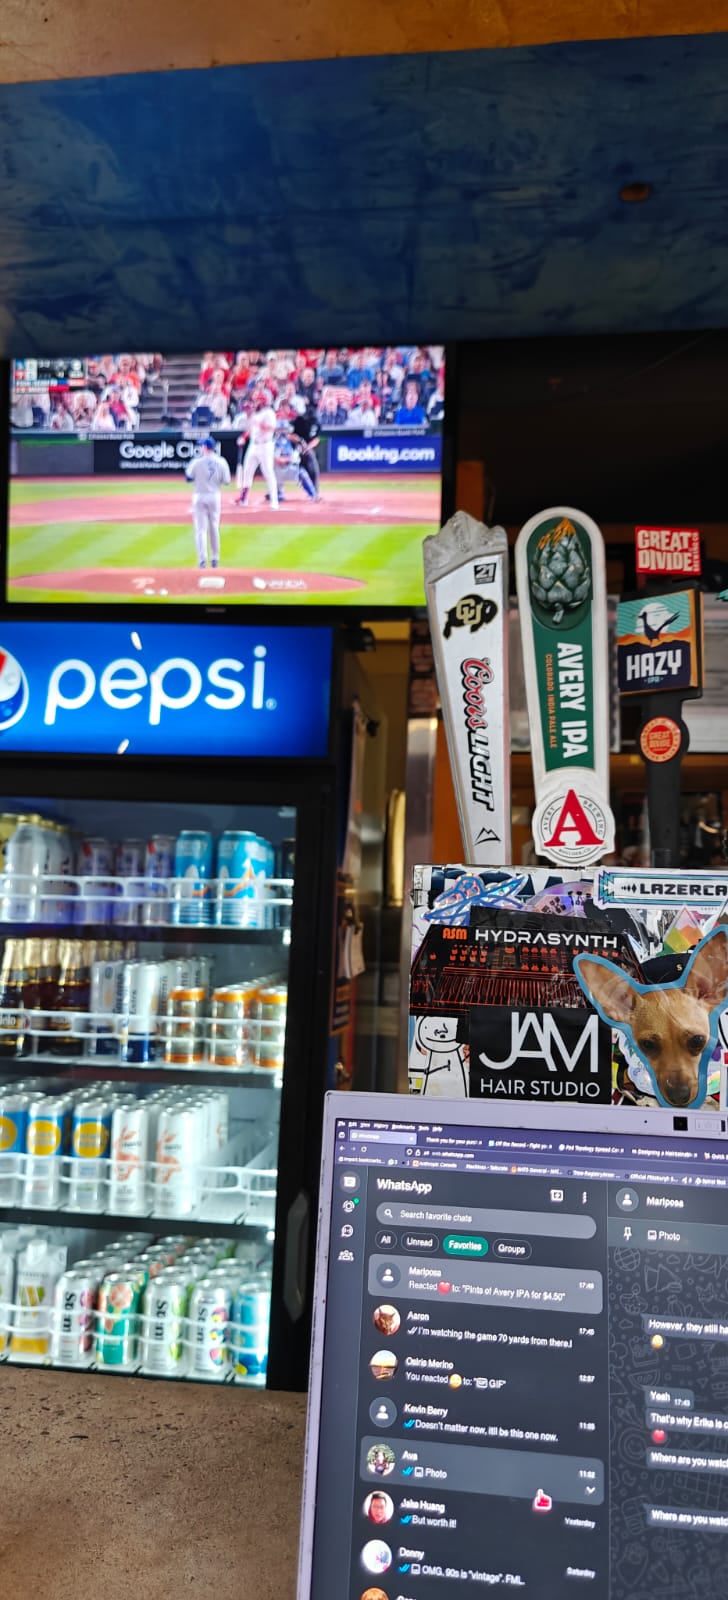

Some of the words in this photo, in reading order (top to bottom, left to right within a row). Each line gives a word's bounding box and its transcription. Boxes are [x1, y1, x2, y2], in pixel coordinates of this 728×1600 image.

[119, 440, 174, 463] Google
[337, 445, 434, 464] Booking.com
[638, 530, 691, 551] GREAT
[638, 549, 693, 572] DIVIDE
[476, 564, 495, 579] 21
[545, 653, 554, 691] COLORADO
[626, 649, 682, 681] HAZY
[557, 642, 586, 711] AVERY
[44, 645, 267, 725] pepsi
[461, 658, 494, 730] Coors
[549, 735, 558, 749] ALE
[561, 720, 589, 758] IPA
[467, 730, 495, 812] LIGHT
[544, 789, 604, 847] A
[640, 883, 727, 896] LAZERCA
[443, 928, 467, 940] ASM
[475, 929, 617, 948] HYDRASYNTH
[478, 1012, 598, 1073] JAM
[480, 1078, 525, 1095] HAIR
[530, 1079, 600, 1097] STUDIO
[377, 1178, 432, 1194] WhatsApp
[400, 1210, 424, 1218] Search
[426, 1212, 451, 1220] favorite
[453, 1214, 472, 1222] chats
[380, 1235, 390, 1243] All
[406, 1237, 432, 1246] Unread
[658, 1230, 681, 1240] Photo
[448, 1240, 481, 1250] Favorites
[498, 1244, 524, 1254] Groups
[409, 1266, 441, 1276] Mariposa
[408, 1280, 438, 1290] Reacted
[484, 1286, 492, 1295] of
[492, 1288, 515, 1300] Avery
[516, 1289, 530, 1298] IPA
[531, 1290, 541, 1299] for
[407, 1311, 429, 1320] Aaron
[648, 1319, 684, 1330] However,
[686, 1322, 702, 1333] they
[704, 1324, 718, 1333] still
[416, 1326, 429, 1334] I'm
[430, 1328, 462, 1339] watching
[476, 1333, 496, 1341] game
[498, 1333, 507, 1341] 70
[508, 1336, 529, 1344] yards
[530, 1336, 547, 1344] from
[428, 1359, 453, 1369] Merino
[406, 1372, 420, 1381] You
[421, 1374, 449, 1384] reacted
[650, 1391, 670, 1401] Yeah
[404, 1403, 426, 1413] Kevin
[426, 1406, 448, 1417] Berry
[650, 1412, 675, 1424] That's
[676, 1416, 692, 1427] why
[715, 1419, 722, 1428] is
[415, 1419, 444, 1429] Doesn't
[444, 1424, 468, 1432] matter
[469, 1426, 486, 1434] now,
[498, 1427, 508, 1436] be
[510, 1429, 523, 1437] this
[524, 1431, 538, 1439] one
[540, 1433, 558, 1441] now.
[402, 1450, 417, 1460] Ava
[651, 1452, 676, 1463] Where
[677, 1456, 690, 1464] are
[692, 1458, 706, 1466] you
[425, 1468, 446, 1478] Photo
[419, 1500, 444, 1513] Huang
[412, 1514, 425, 1524] But
[426, 1518, 448, 1526] worth
[564, 1517, 595, 1528] Yesterday
[651, 1510, 677, 1521] Where
[678, 1514, 692, 1522] are
[692, 1515, 708, 1524] you
[399, 1547, 424, 1559] Donny
[445, 1568, 459, 1577] 90s
[460, 1569, 467, 1578] is
[505, 1574, 524, 1584] FML.
